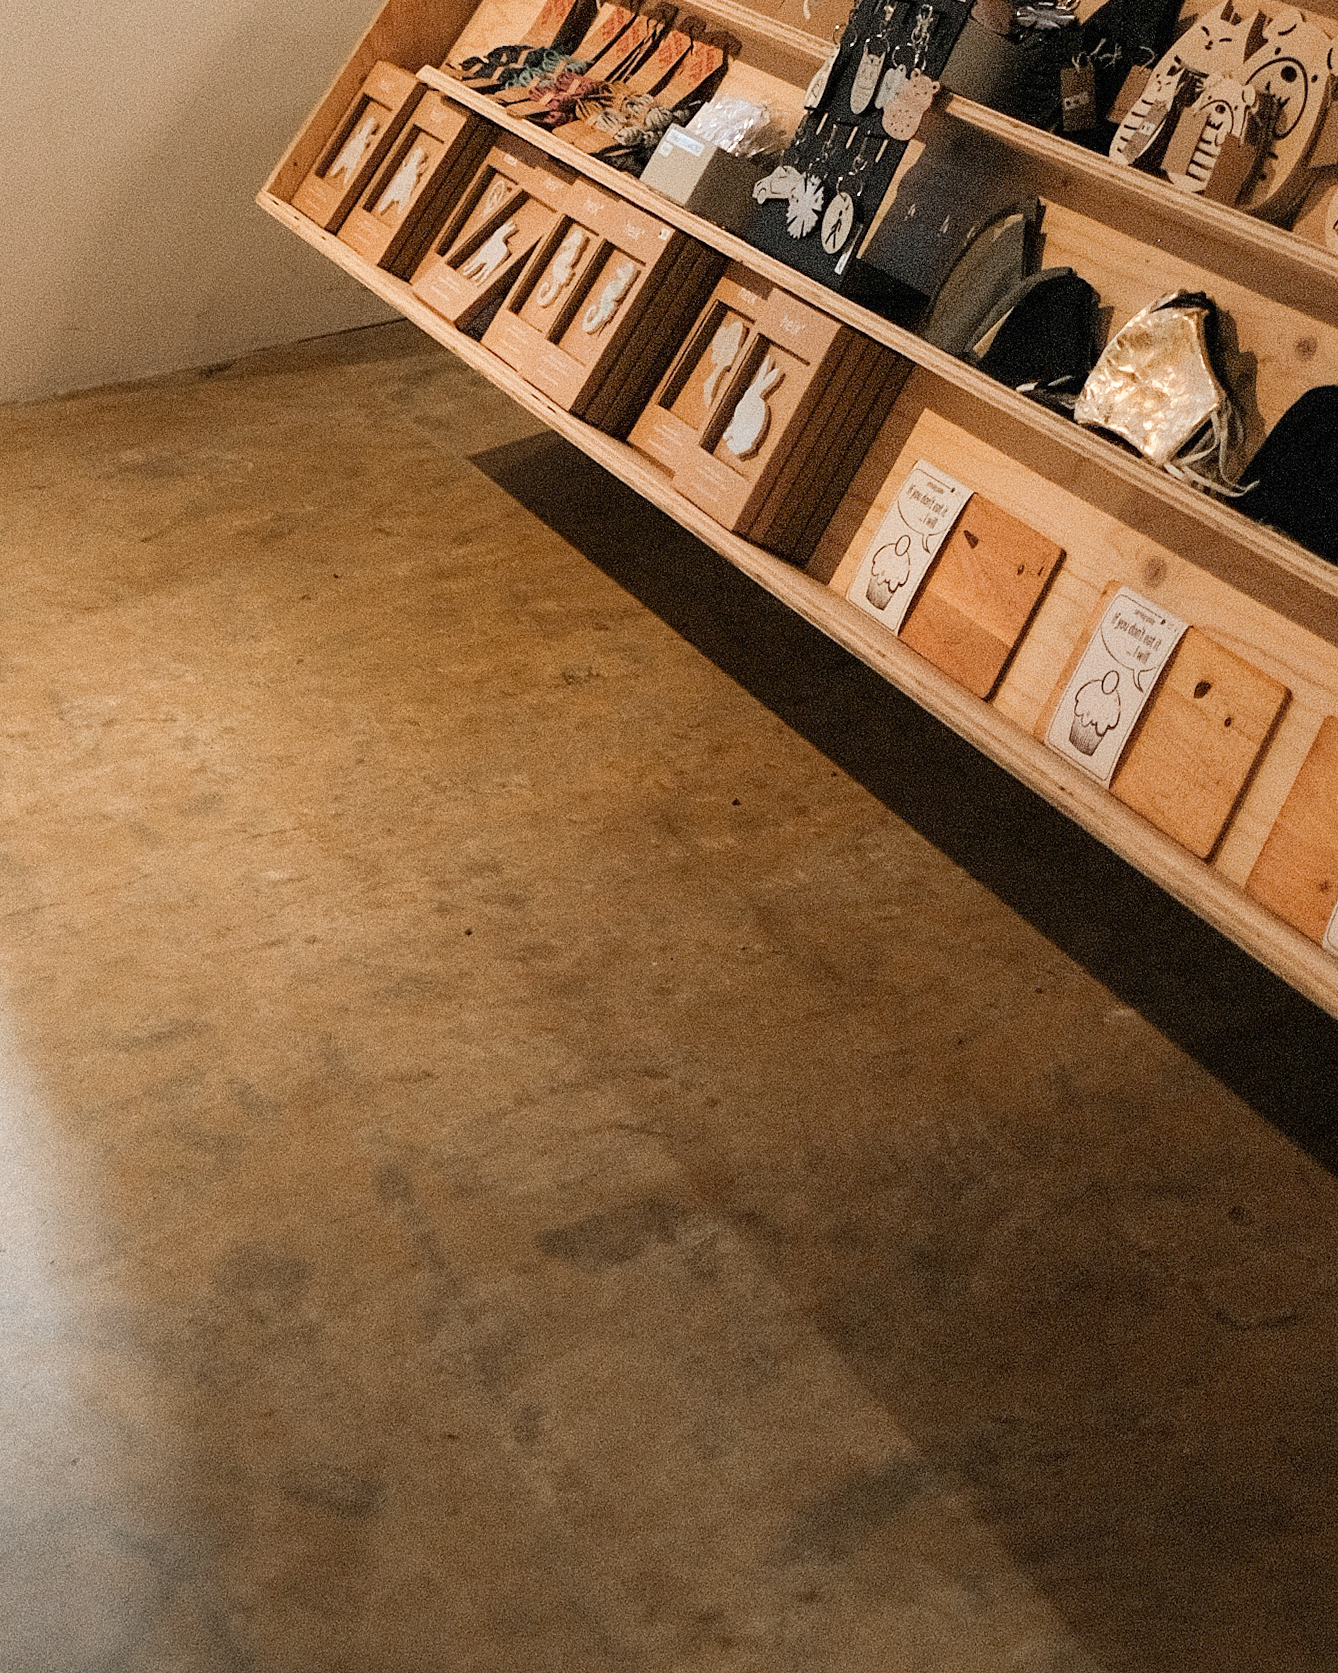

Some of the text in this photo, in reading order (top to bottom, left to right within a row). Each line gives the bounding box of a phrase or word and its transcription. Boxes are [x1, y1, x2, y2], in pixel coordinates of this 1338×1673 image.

[1114, 619, 1130, 632] you
[1127, 624, 1146, 640] don't
[1143, 635, 1155, 647] eat
